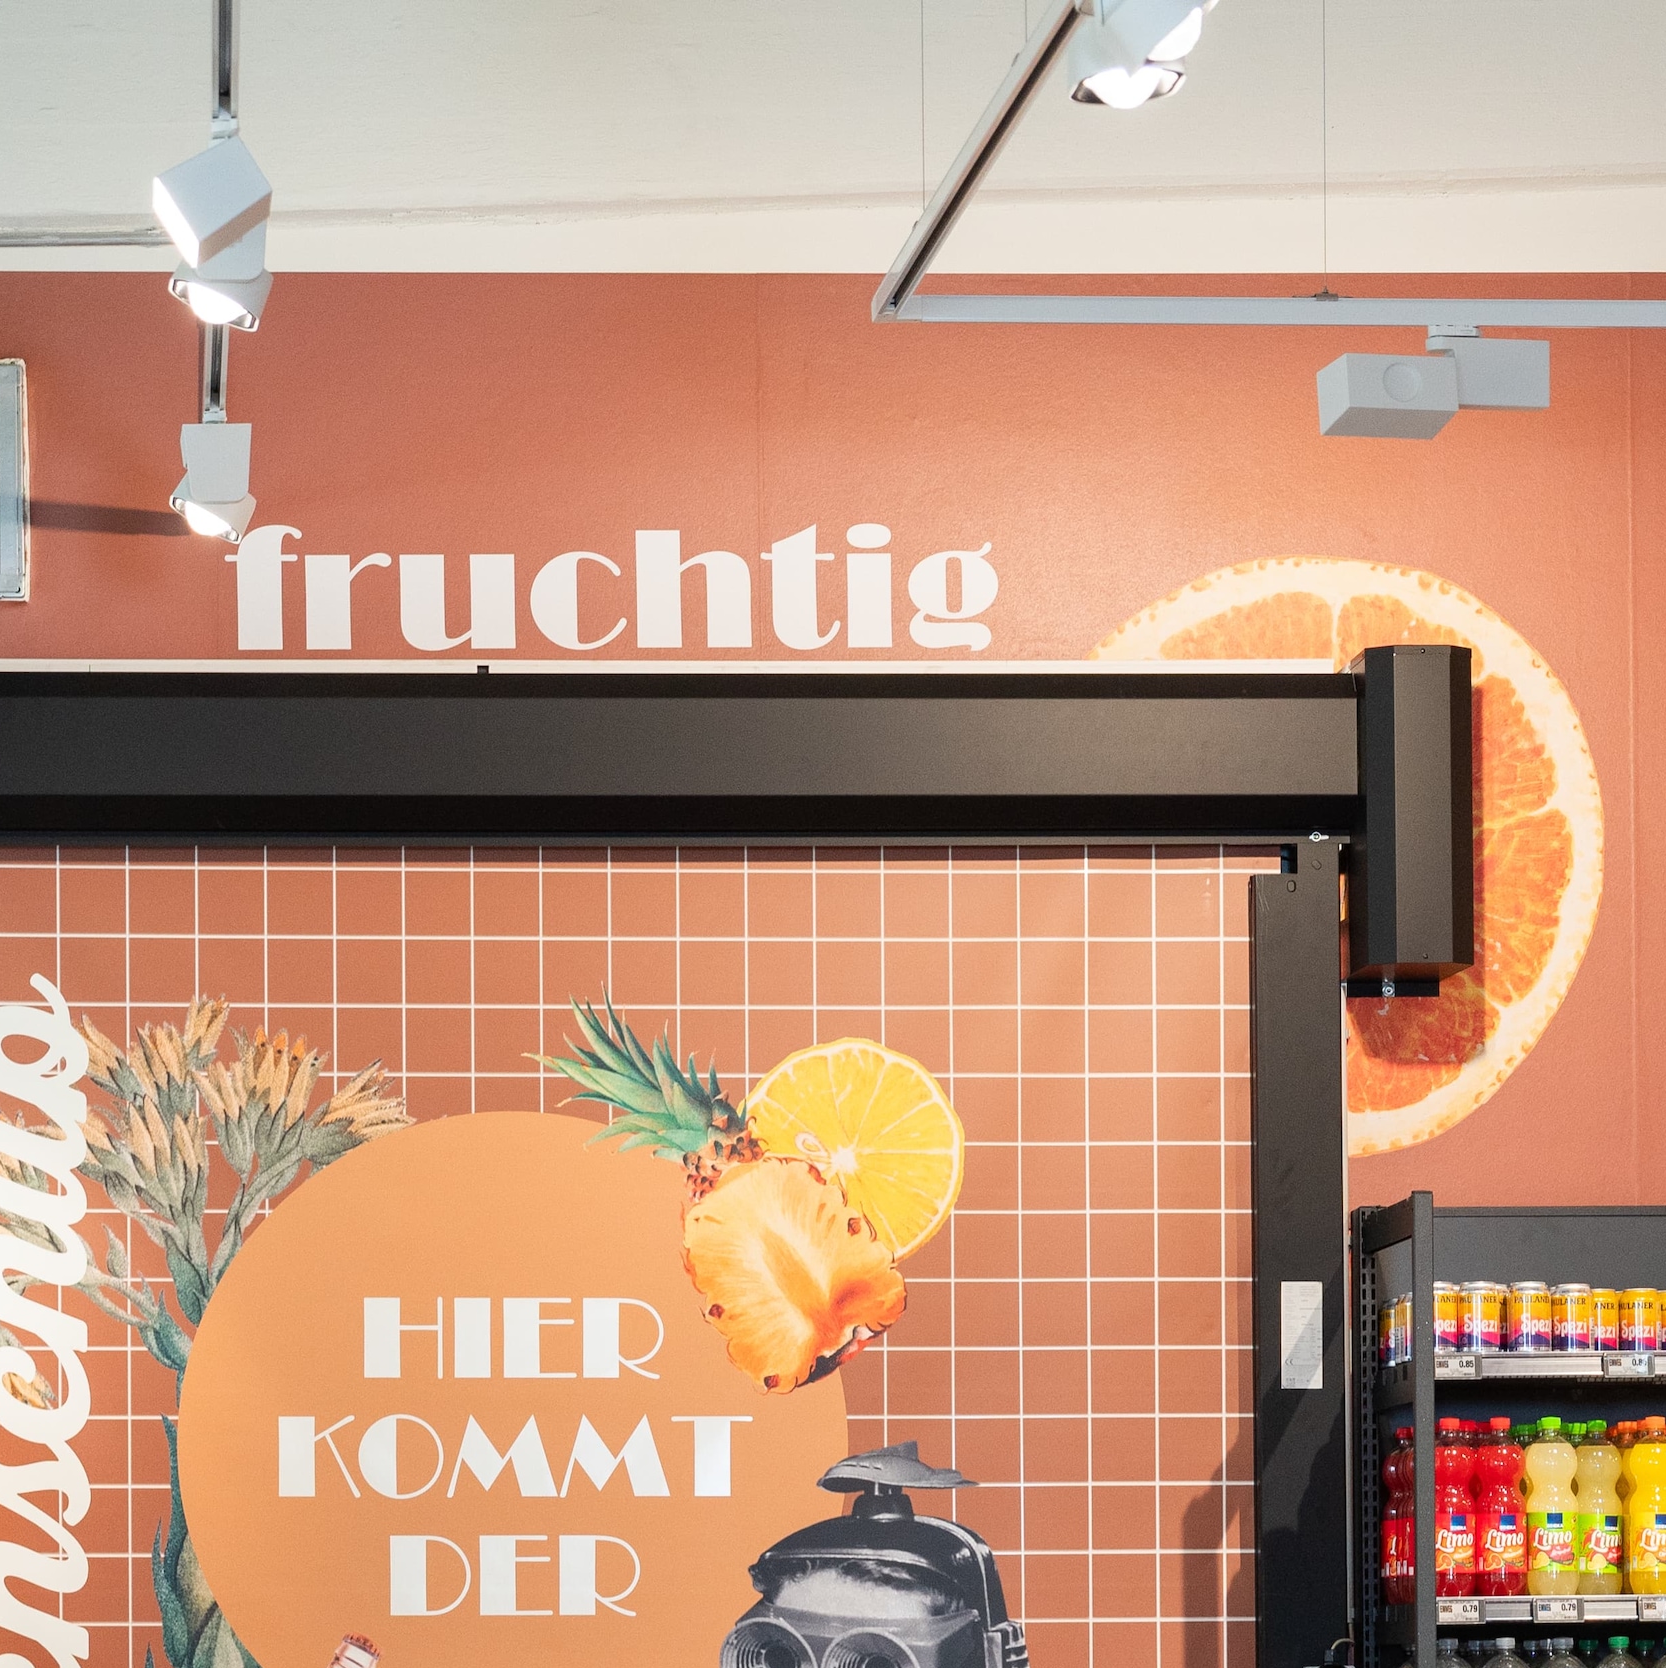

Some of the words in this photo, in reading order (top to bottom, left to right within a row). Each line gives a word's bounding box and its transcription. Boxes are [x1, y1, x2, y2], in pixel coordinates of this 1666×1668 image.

[224, 523, 1000, 652] fruchtig
[363, 1297, 665, 1381] HIER
[1459, 1360, 1474, 1369] 0.85
[277, 1415, 754, 1498] KOMMT
[1436, 1528, 1474, 1552] Limo
[1485, 1528, 1524, 1552] Limo
[1533, 1528, 1572, 1550] Limo
[389, 1535, 643, 1617] DER
[1462, 1604, 1478, 1613] 0.79
[1561, 1603, 1576, 1612] 0.79
